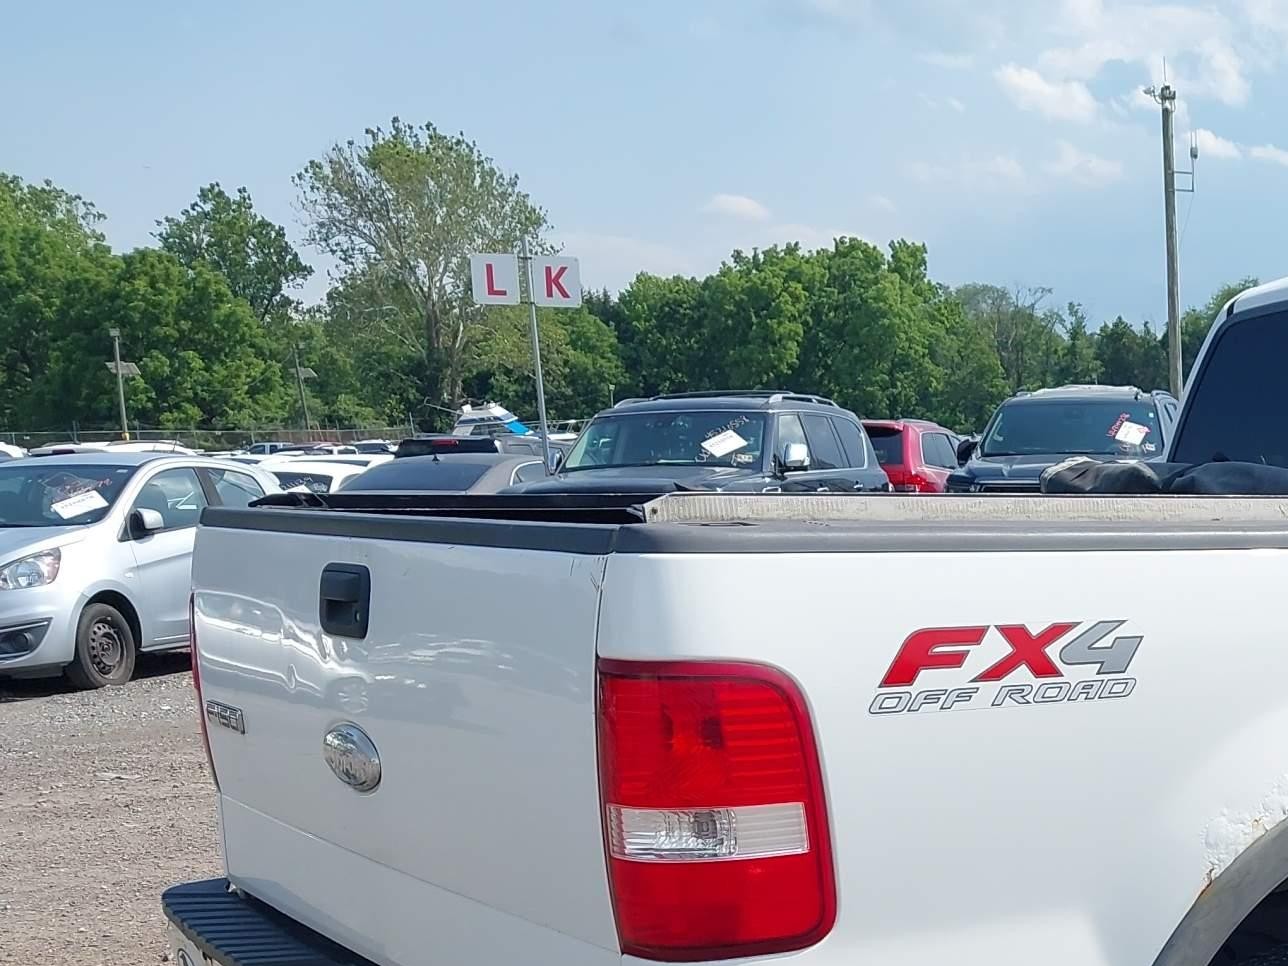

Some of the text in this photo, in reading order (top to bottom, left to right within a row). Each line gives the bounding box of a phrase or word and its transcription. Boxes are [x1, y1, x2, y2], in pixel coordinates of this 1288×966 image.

[486, 263, 507, 296] L
[545, 266, 571, 298] K
[878, 619, 1144, 688] FX4
[868, 677, 1137, 714] OFF ROAD
